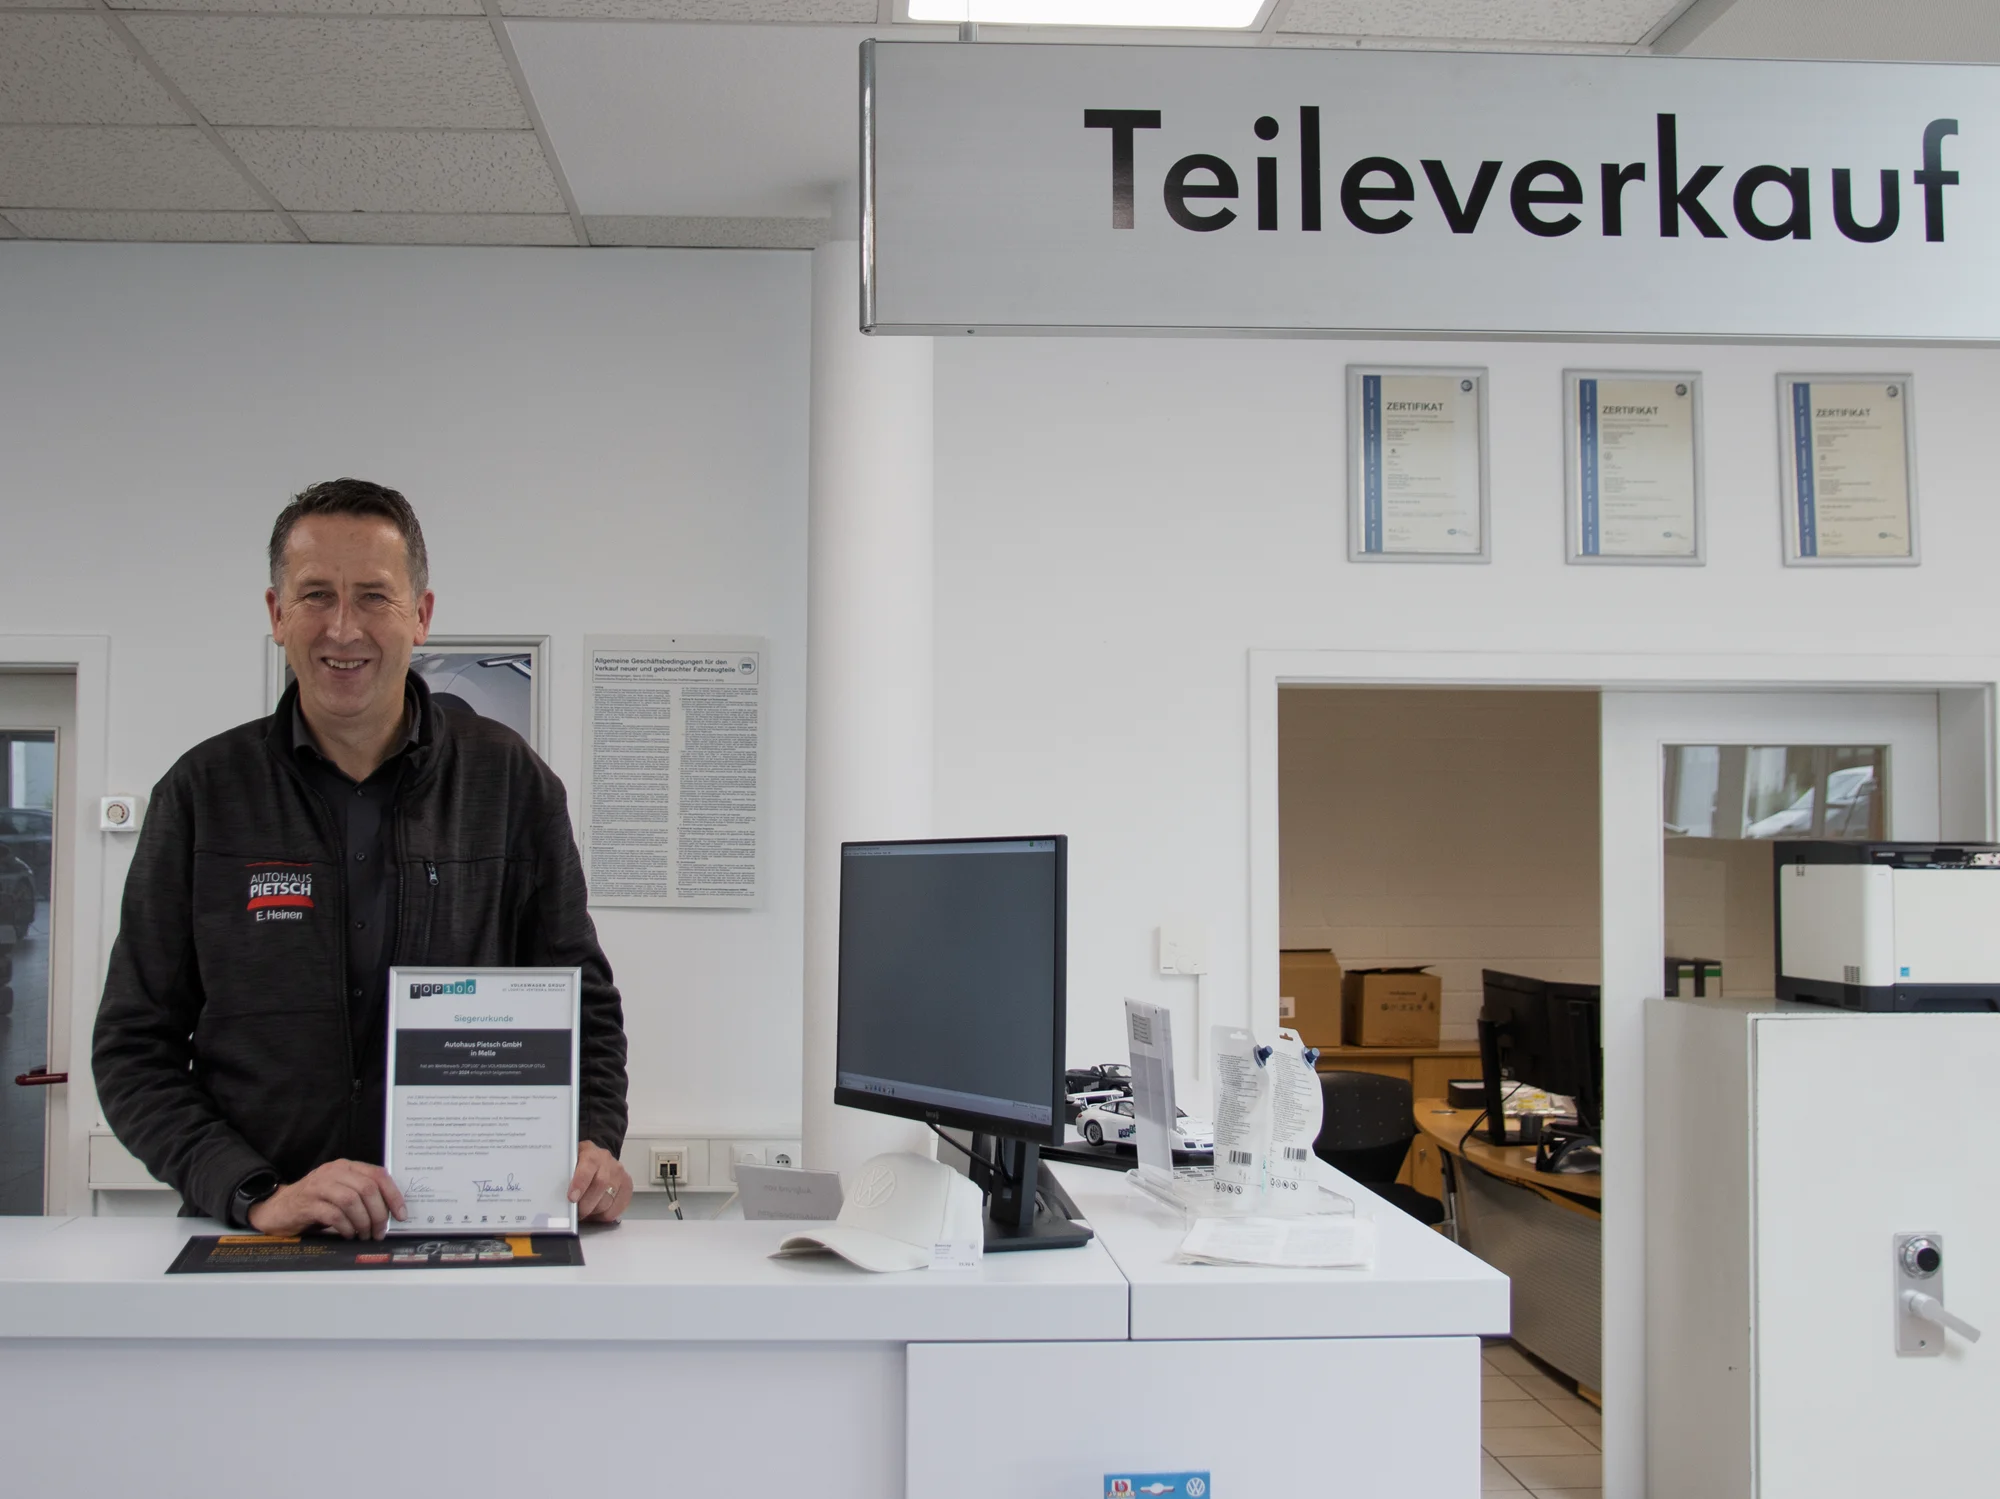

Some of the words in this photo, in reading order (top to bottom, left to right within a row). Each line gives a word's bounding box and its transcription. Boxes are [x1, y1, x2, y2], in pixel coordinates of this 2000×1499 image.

[1083, 105, 1961, 244] Teileverkauf
[1386, 401, 1445, 412] ZERTIFIKAT
[1602, 405, 1659, 415] ZERTIFIKAT
[1815, 408, 1871, 418] ZERTIFIKAT
[594, 657, 630, 666] Allgemeine
[630, 657, 704, 667] Geschäftsbedingungen
[704, 658, 714, 666] für
[715, 658, 728, 666] den
[653, 666, 692, 674] gebrauchter
[693, 666, 736, 674] Fahrzeugteile
[250, 872, 313, 885] AUTOHAUS
[250, 882, 312, 898] PIETSCH
[266, 909, 303, 920] Heinen
[412, 983, 475, 995] TOP100
[454, 1014, 514, 1024] Siegerurkunde
[477, 1049, 497, 1057] Melle
